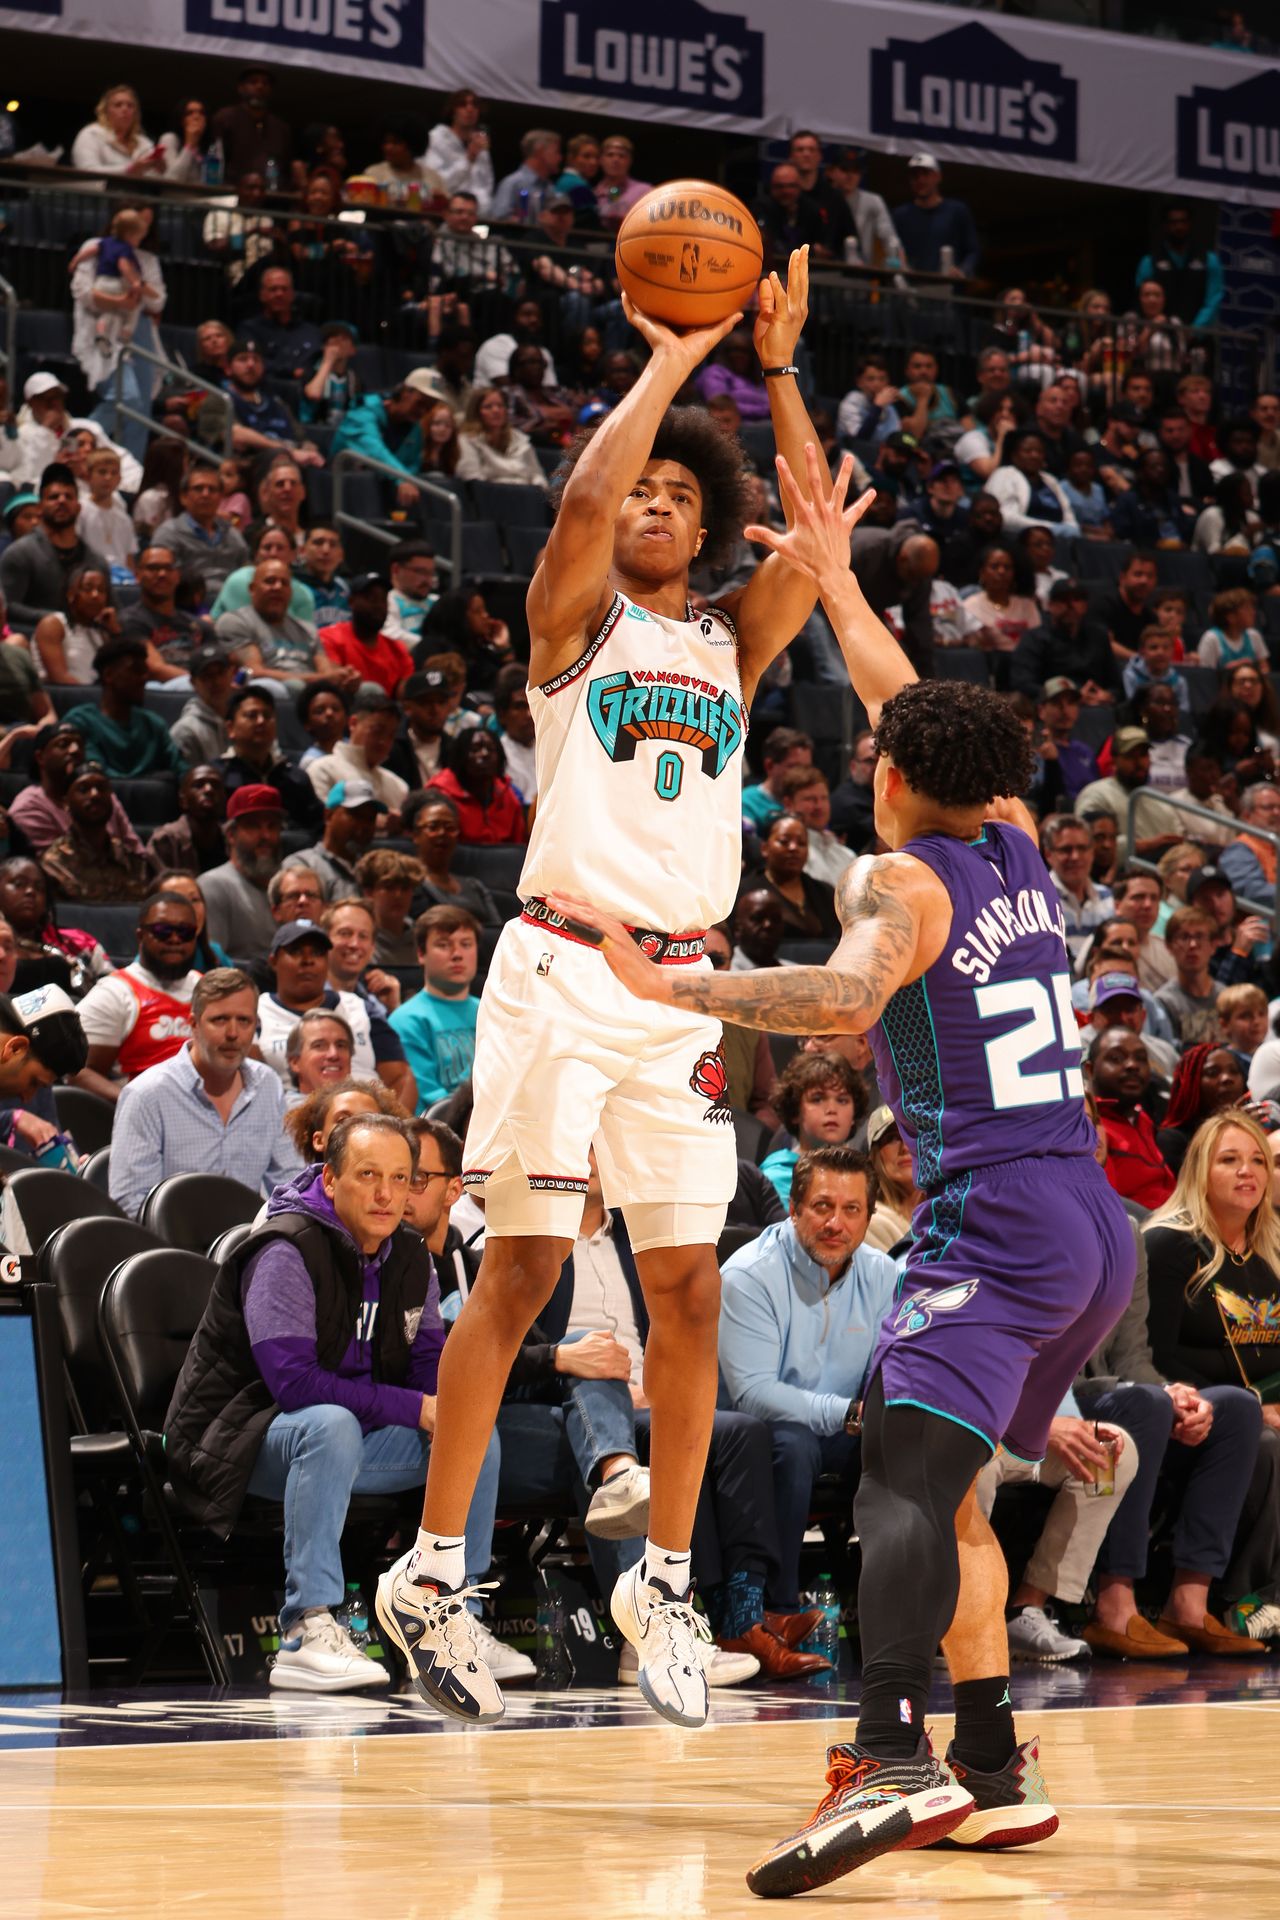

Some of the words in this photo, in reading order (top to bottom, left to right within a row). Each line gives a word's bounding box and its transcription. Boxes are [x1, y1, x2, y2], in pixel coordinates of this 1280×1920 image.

[563, 12, 744, 101] LOWE'S
[892, 60, 1058, 146] LOWE'S
[647, 198, 743, 238] Wilson
[630, 604, 649, 621] NIKE
[632, 670, 720, 699] VANCOUVER
[586, 670, 742, 781] GRIZZLIES
[653, 749, 685, 802] 0
[952, 889, 1055, 984] SIMPSON
[0, 1255, 22, 1284] G
[223, 1633, 244, 1657] 17
[569, 1607, 597, 1643] 19
